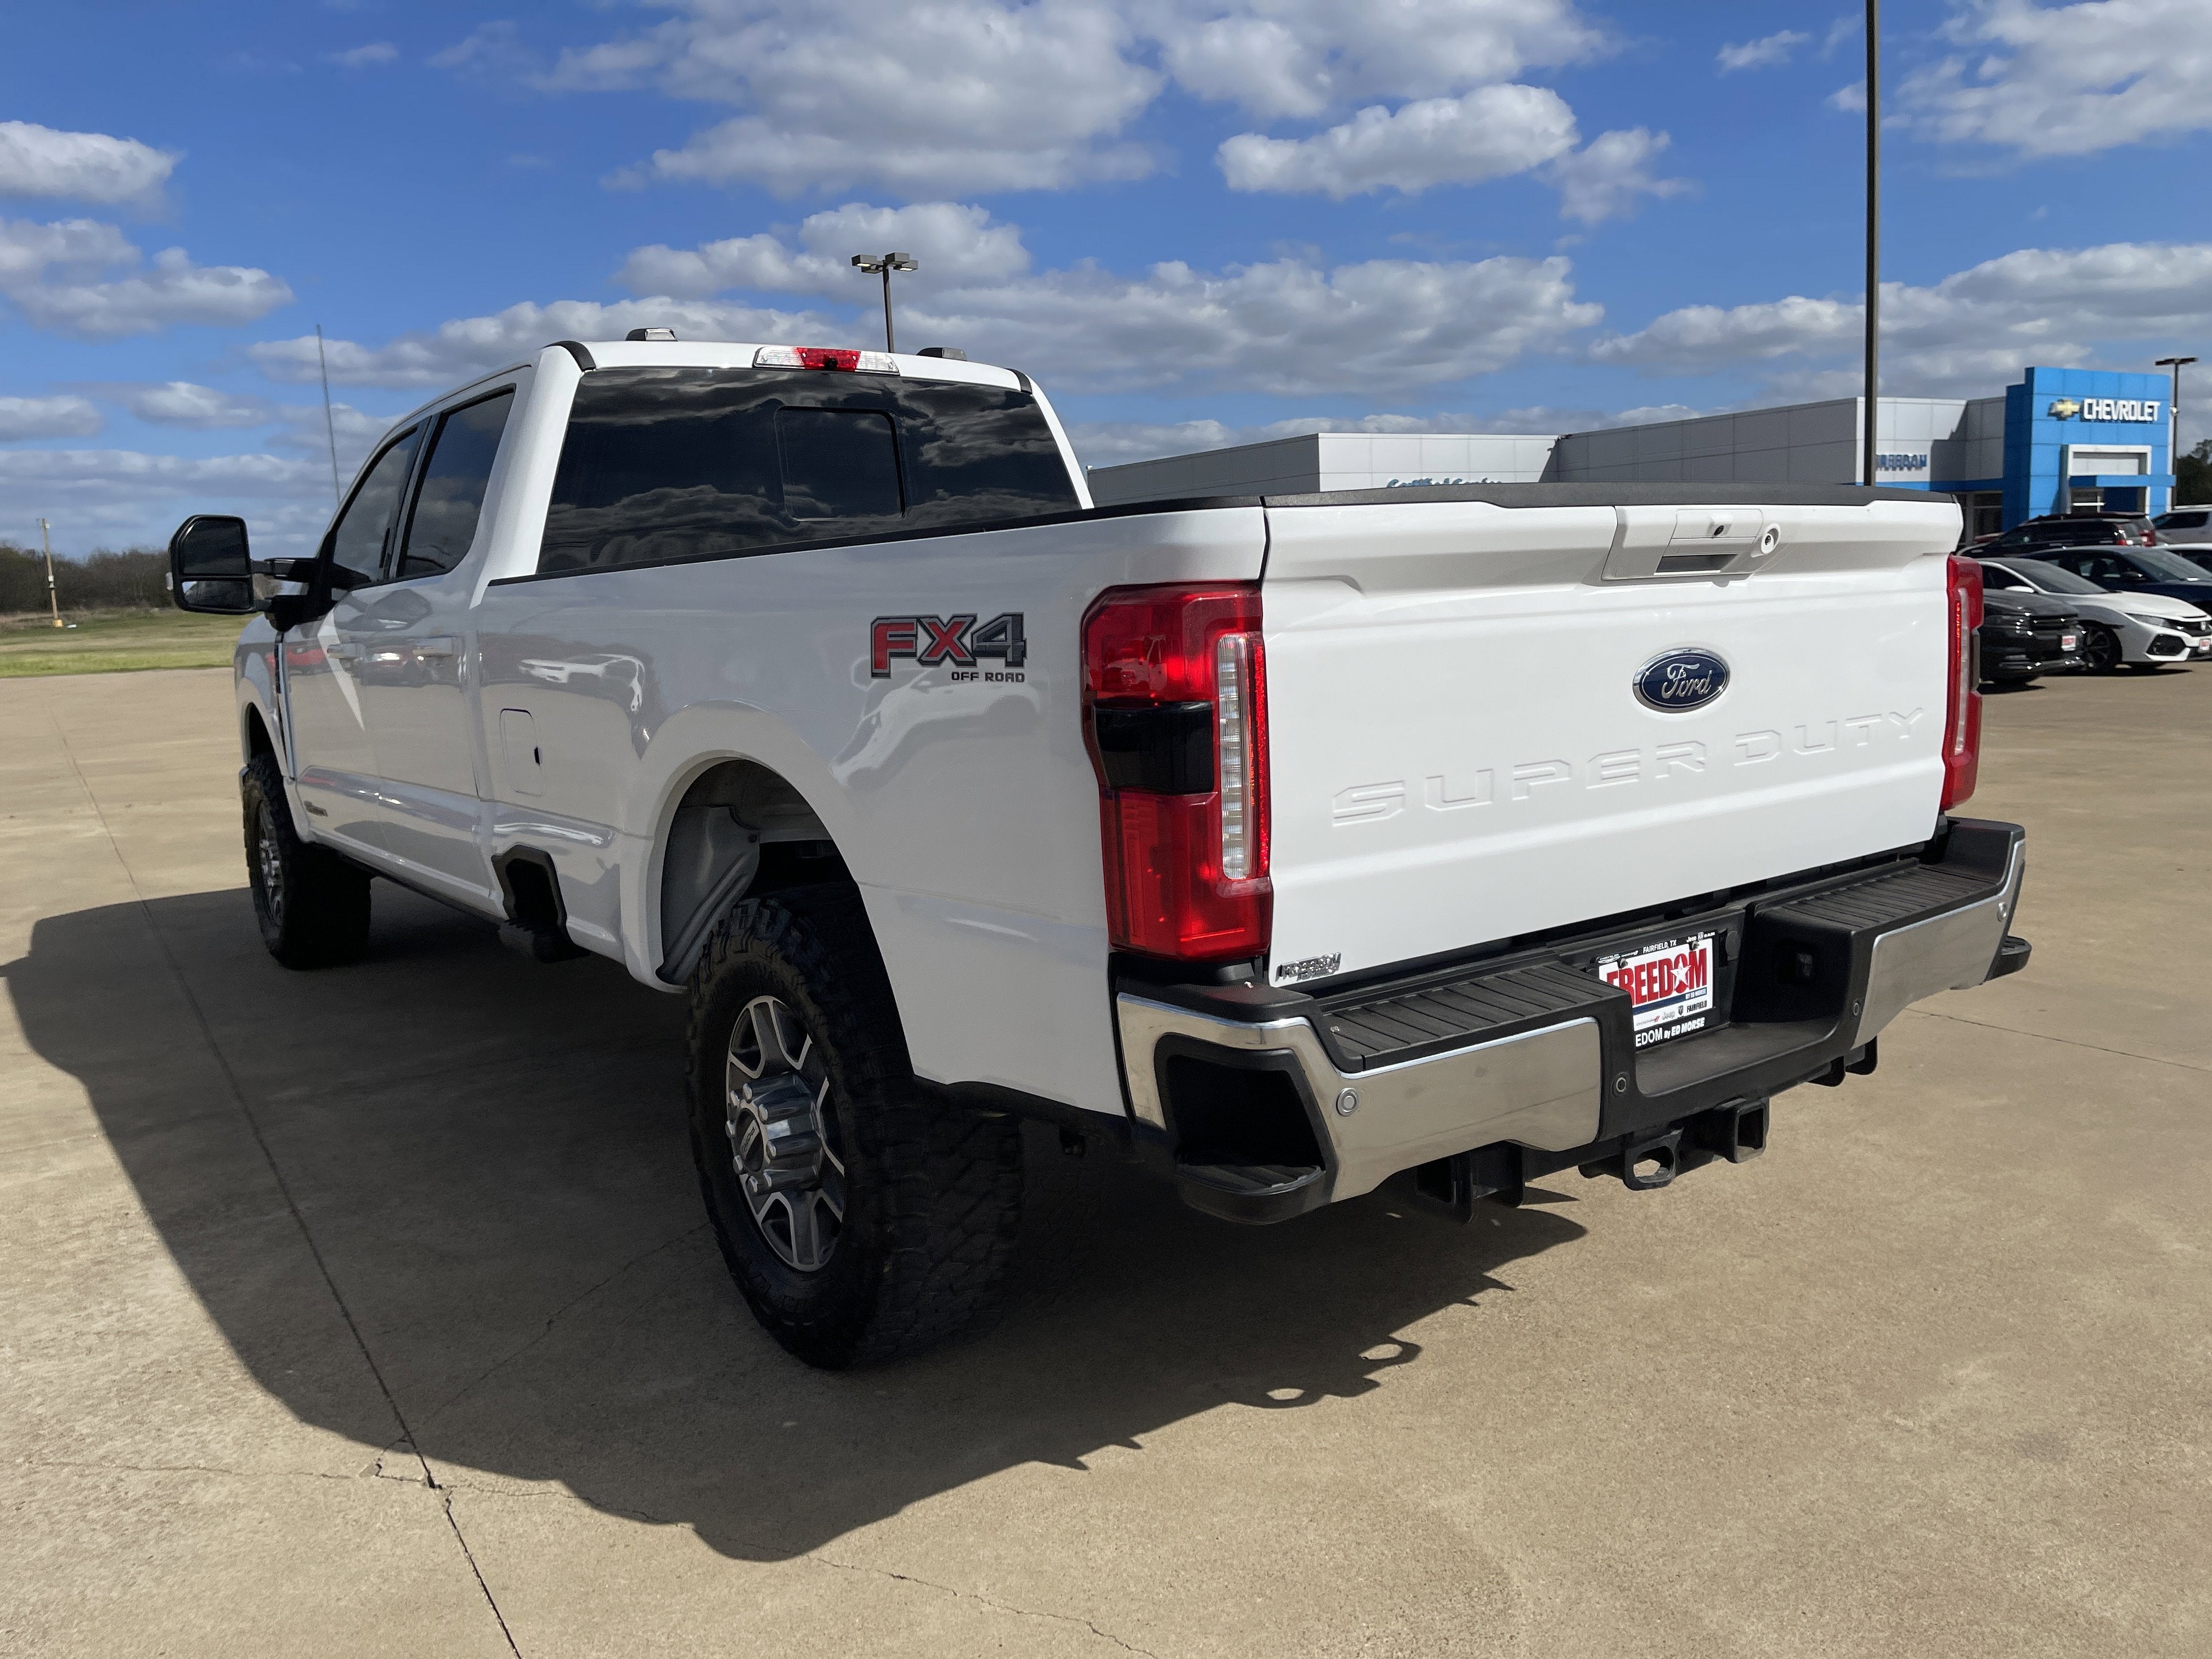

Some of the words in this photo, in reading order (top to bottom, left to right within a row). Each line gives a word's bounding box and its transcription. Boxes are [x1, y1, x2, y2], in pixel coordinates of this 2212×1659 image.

[2084, 399, 2160, 421] CHEVROLET
[871, 612, 1027, 679] FX4
[951, 671, 979, 681] OFF
[985, 672, 1025, 682] ROAD
[1661, 663, 1712, 699] Ford
[1332, 740, 1706, 827] SUPER
[1734, 707, 1923, 766] DUTY
[1686, 1000, 1707, 1013] FAIRFIELD
[1635, 1028, 1663, 1047] EDOM
[1671, 1025, 1680, 1036] ED
[1681, 1017, 1705, 1034] MORSE
